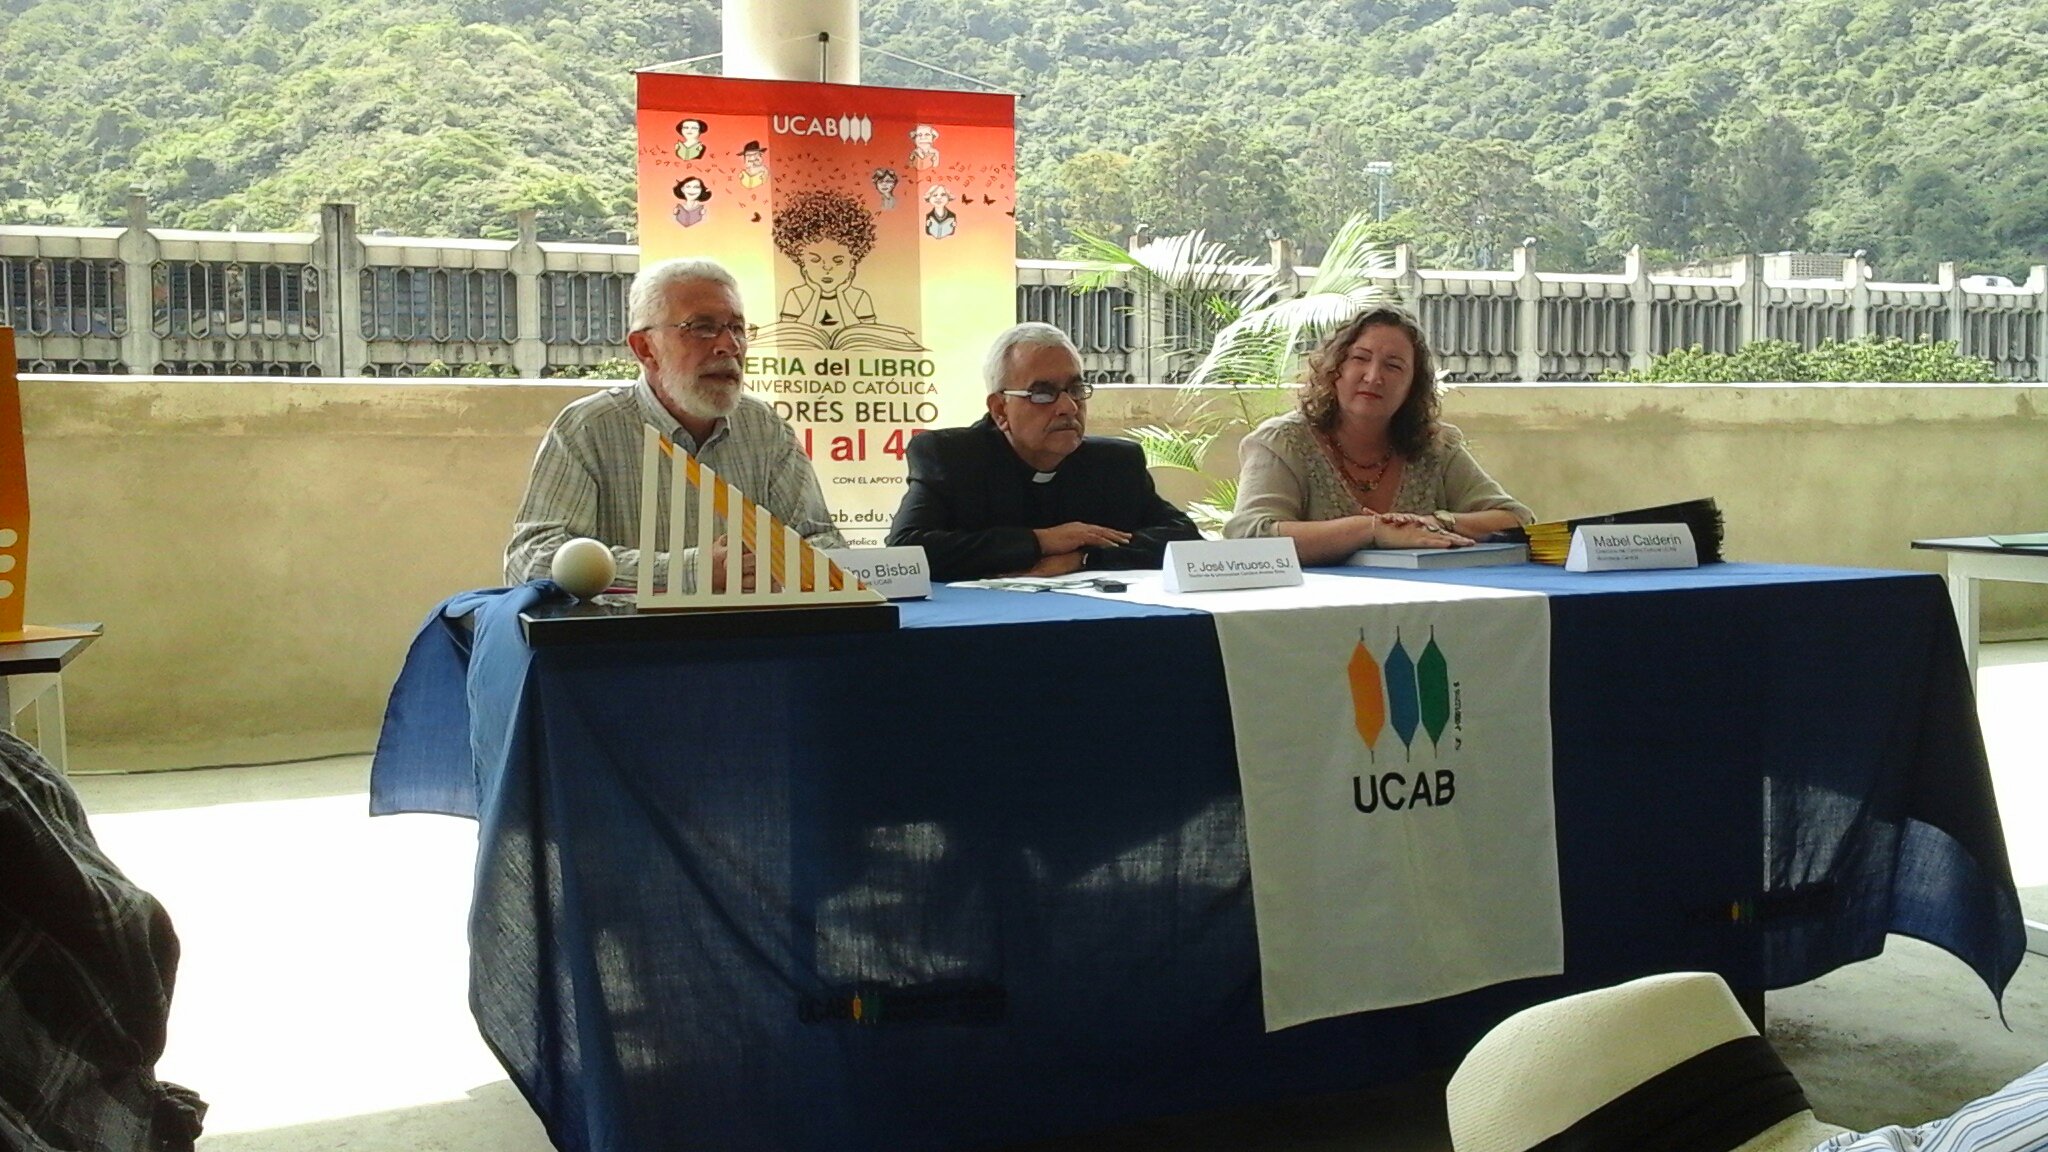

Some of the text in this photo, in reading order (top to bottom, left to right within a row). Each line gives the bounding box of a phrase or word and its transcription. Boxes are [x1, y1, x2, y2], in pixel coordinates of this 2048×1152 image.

[773, 114, 839, 137] UCAB
[744, 356, 935, 377] ERIA del LIBRO
[742, 378, 938, 395] NIVERSIDAD CATÓLICA
[774, 396, 939, 423] DRÉS BELLO
[830, 428, 866, 461] al
[832, 476, 903, 485] CON EL APOYO
[1593, 535, 1630, 547] Mabel
[875, 563, 920, 577] Bisbal
[1187, 562, 1197, 572] P.
[1353, 769, 1456, 814] UCAB
